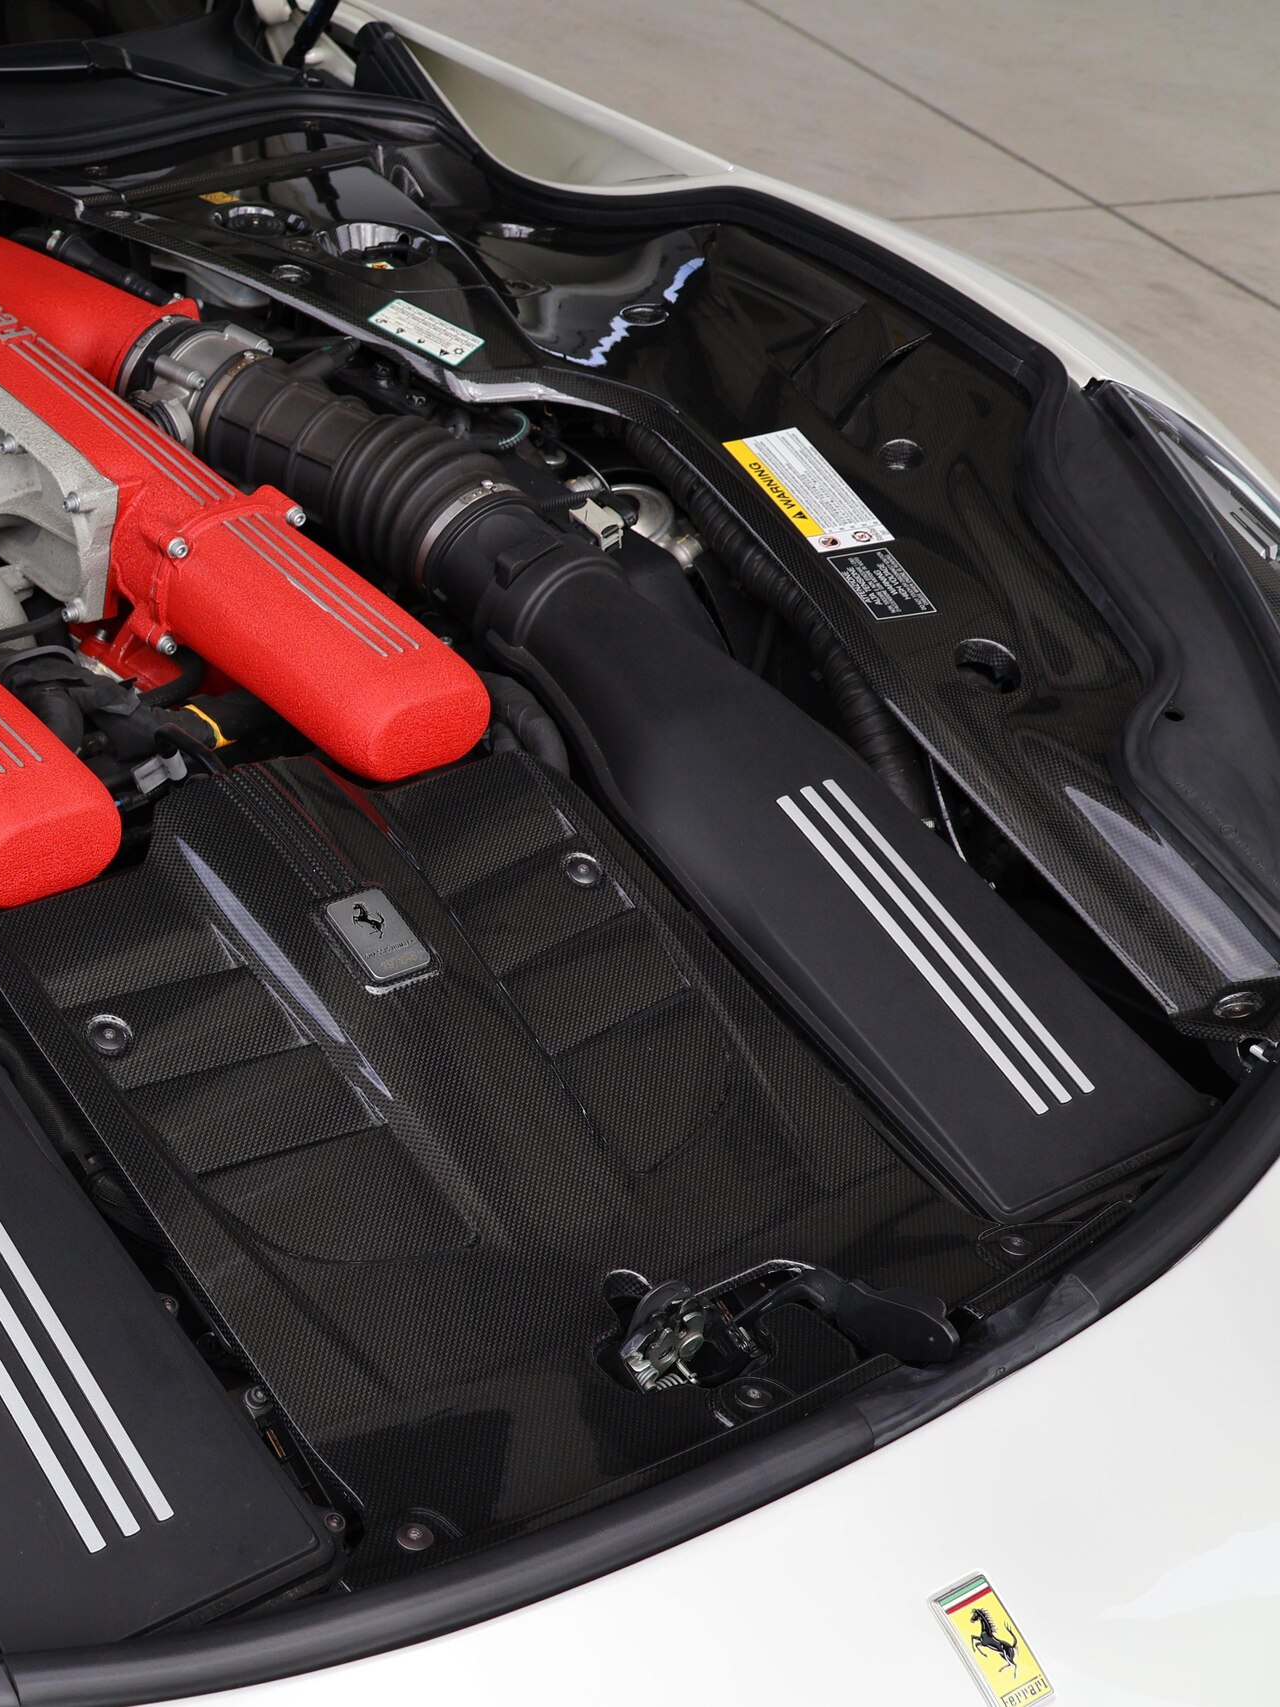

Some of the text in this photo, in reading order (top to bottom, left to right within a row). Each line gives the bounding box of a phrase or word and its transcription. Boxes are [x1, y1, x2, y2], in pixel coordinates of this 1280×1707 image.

[749, 462, 796, 509] WARNING
[872, 569, 898, 595] WARNING
[875, 562, 911, 600] HIGH VOLTAGE
